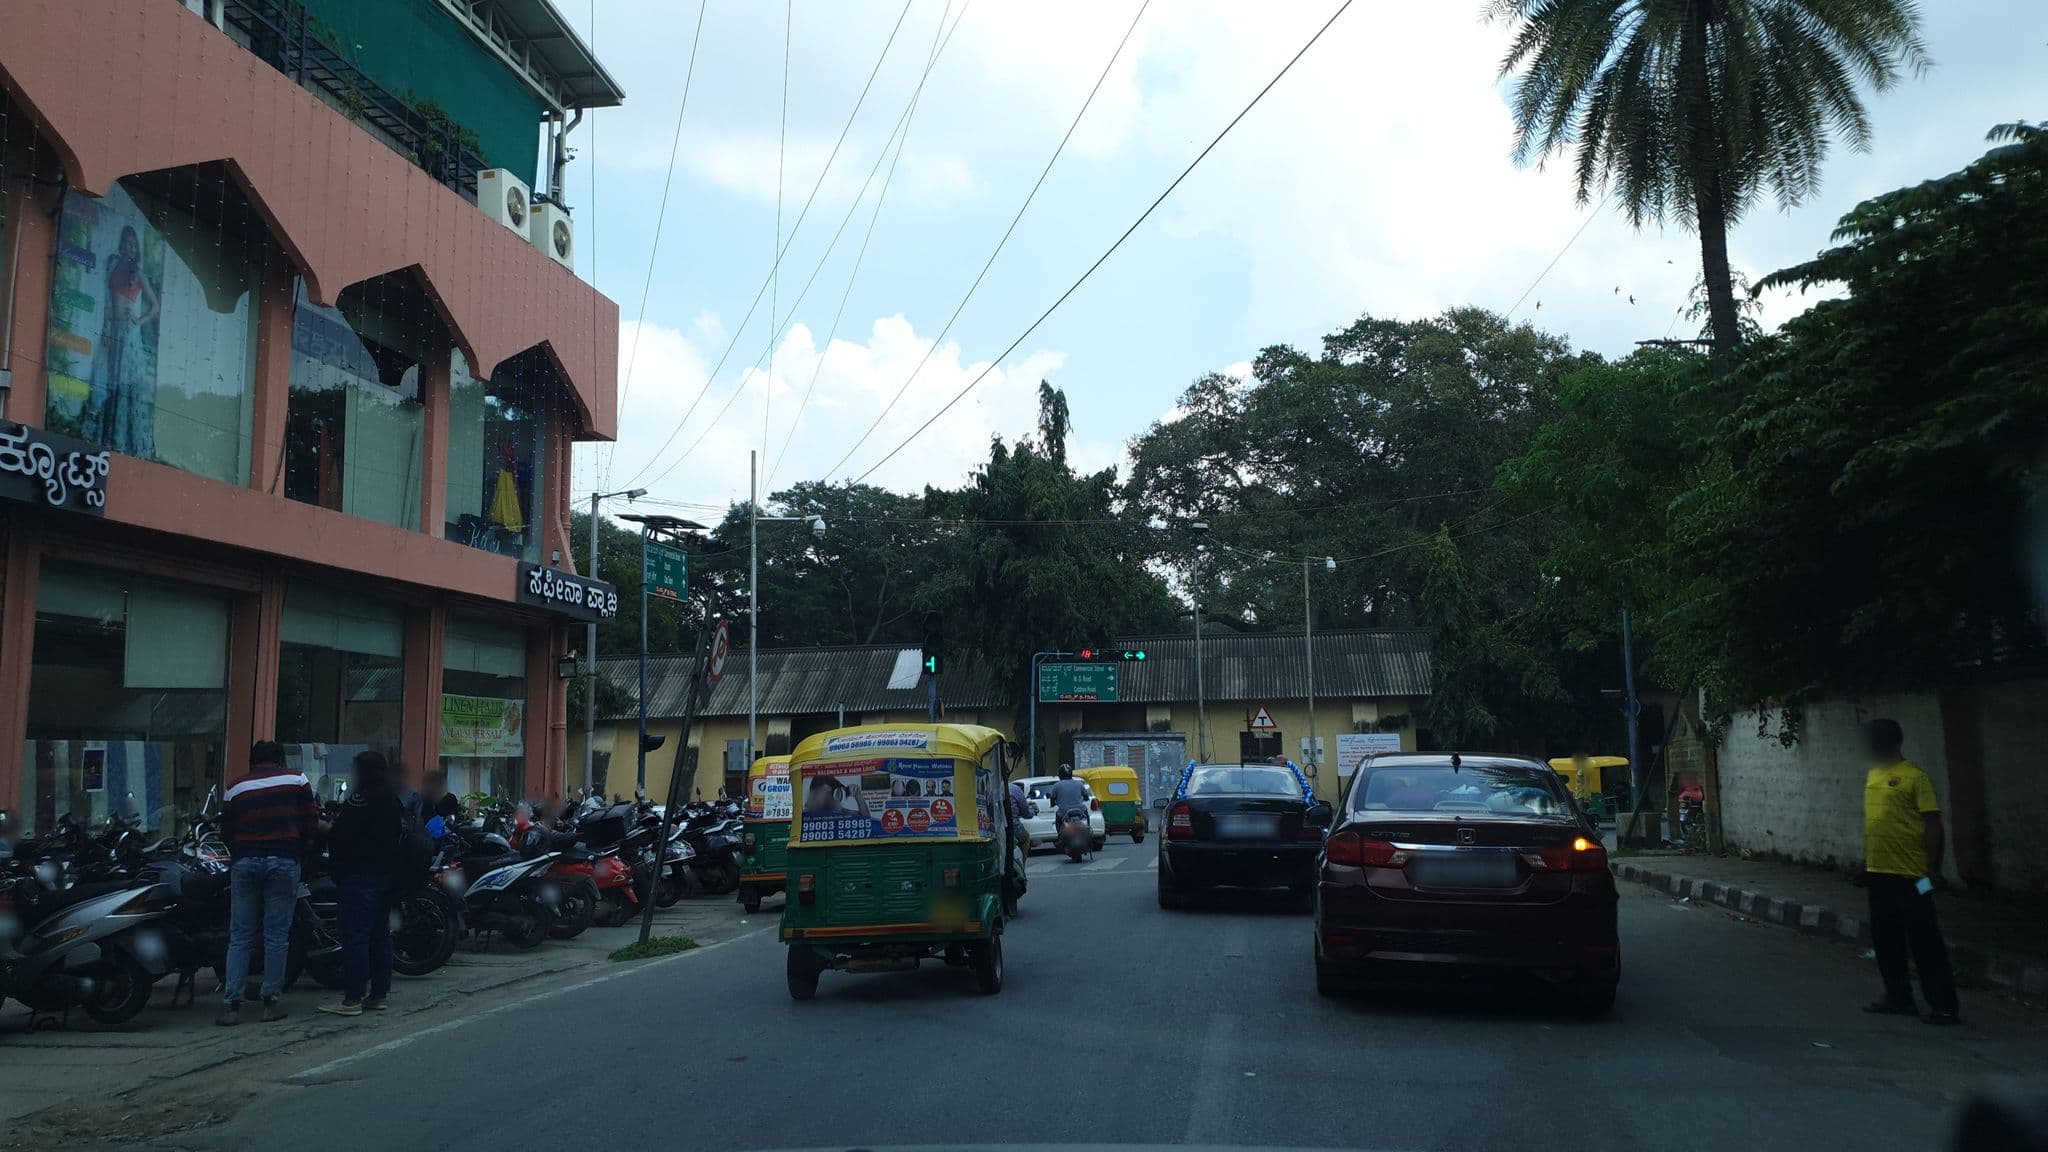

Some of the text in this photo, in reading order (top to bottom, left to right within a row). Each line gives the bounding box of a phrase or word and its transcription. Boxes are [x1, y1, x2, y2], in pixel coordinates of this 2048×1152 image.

[443, 697, 473, 713] LINEN
[803, 819, 872, 831] 99003 58985
[802, 829, 872, 840] 99003 54287
